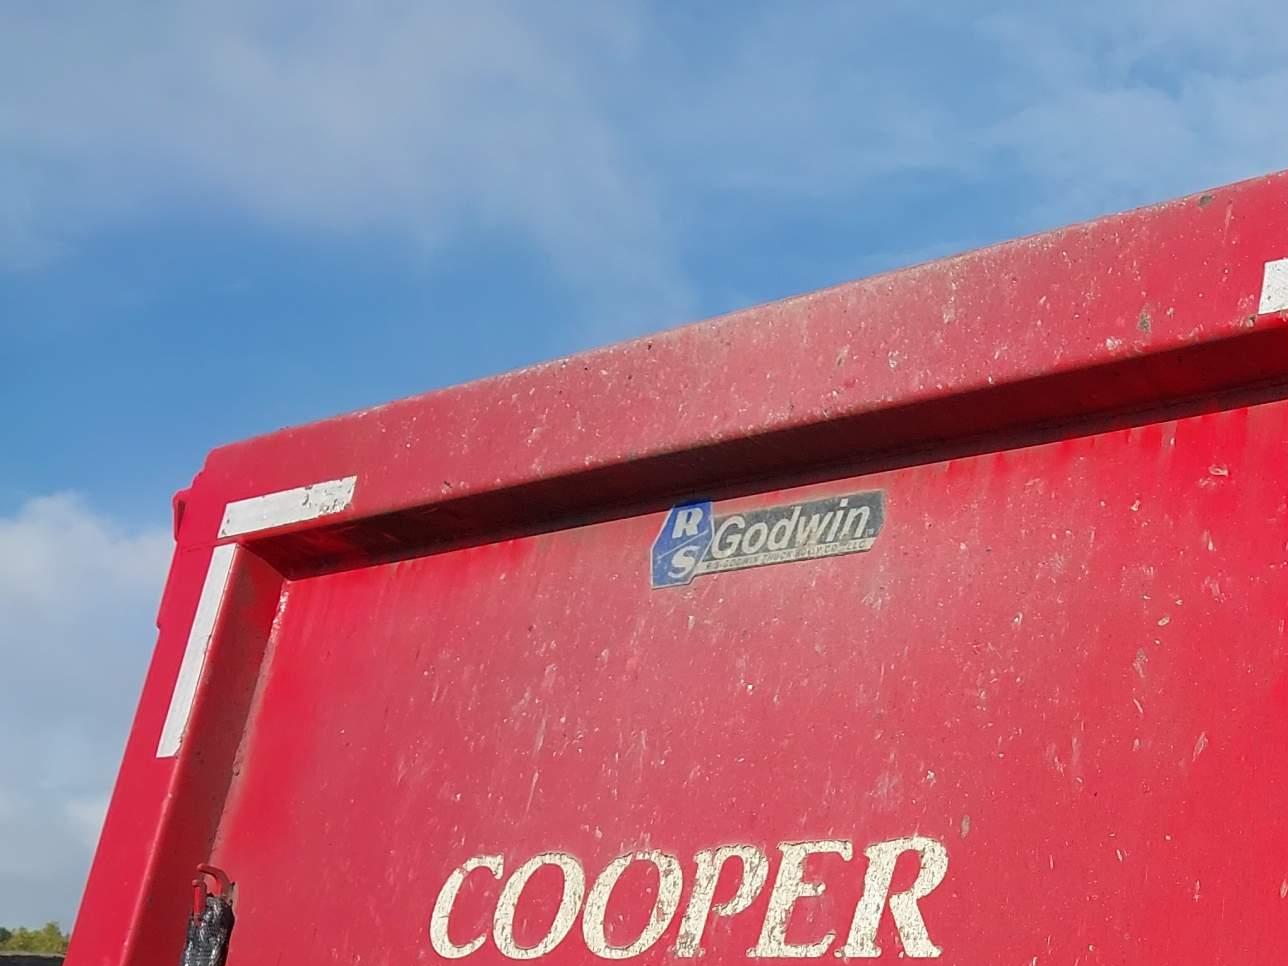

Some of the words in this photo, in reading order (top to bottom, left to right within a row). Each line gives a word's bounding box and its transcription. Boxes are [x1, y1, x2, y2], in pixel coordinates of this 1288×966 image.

[672, 507, 704, 539] R
[711, 498, 870, 559] Godwin
[667, 545, 701, 578] S
[429, 837, 949, 960] COOPER
